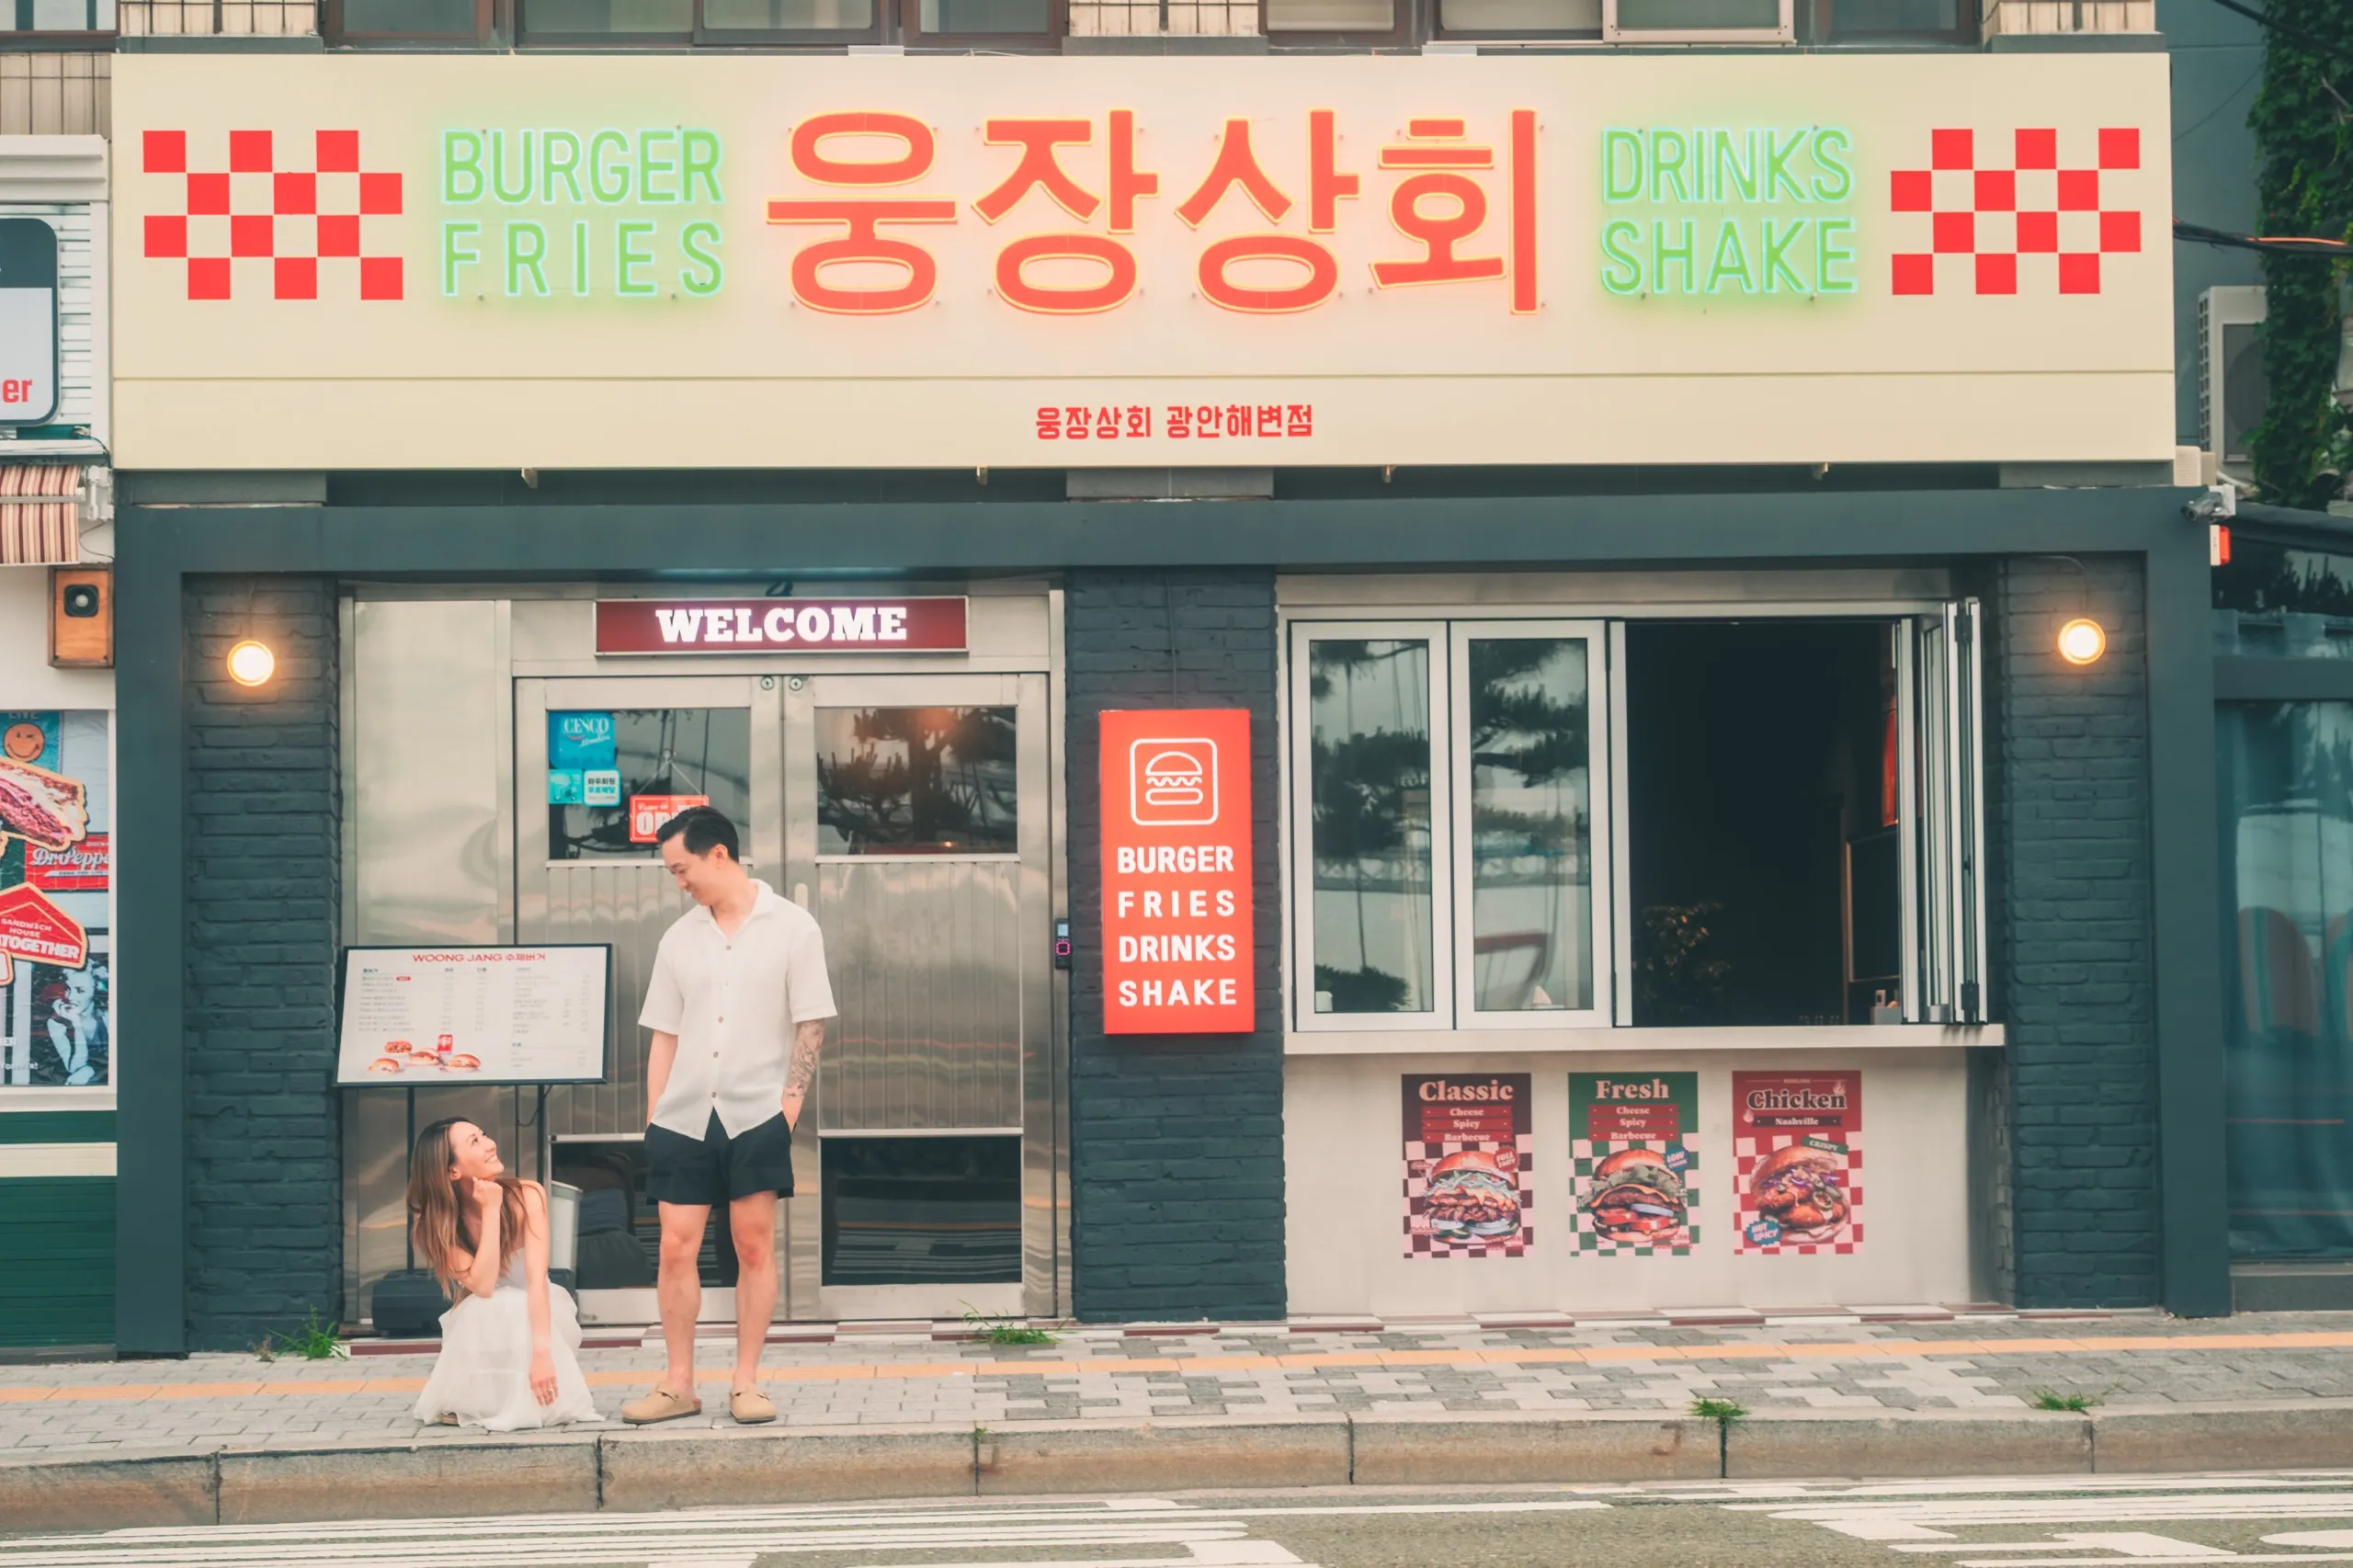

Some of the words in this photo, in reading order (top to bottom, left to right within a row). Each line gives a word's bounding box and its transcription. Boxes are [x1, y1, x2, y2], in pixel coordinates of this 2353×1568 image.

[442, 128, 724, 204] BURGER
[1601, 126, 1854, 204] DRINKS
[765, 108, 1540, 315] 웅장상회
[442, 220, 725, 297] FRIES
[1600, 217, 1859, 295] SHAKE
[1036, 405, 1152, 440] 웅장상회
[1166, 404, 1313, 439] 광안해변점
[655, 606, 908, 643] WELCOME
[1117, 846, 1234, 874] BURGER
[1118, 890, 1235, 918] FRIES
[1, 917, 52, 932] SANDWICH
[9, 927, 41, 938] HOUSE
[413, 953, 465, 962] WOONG
[467, 953, 503, 962] JANG
[505, 952, 546, 962] 수제버거
[1119, 934, 1236, 962] DRINKS
[1119, 979, 1237, 1007] SHAKE
[1418, 1079, 1516, 1102] Classic
[1595, 1078, 1669, 1099] Fresh
[1746, 1087, 1847, 1110] Chicken
[1449, 1107, 1484, 1117] Cheese
[1616, 1106, 1651, 1116] Cheese
[1775, 1117, 1820, 1126] Nashville
[1452, 1119, 1481, 1130] Spicy
[1619, 1118, 1647, 1128] Spicy
[1444, 1132, 1491, 1142] Barbecue
[1610, 1131, 1657, 1141] Barbecue
